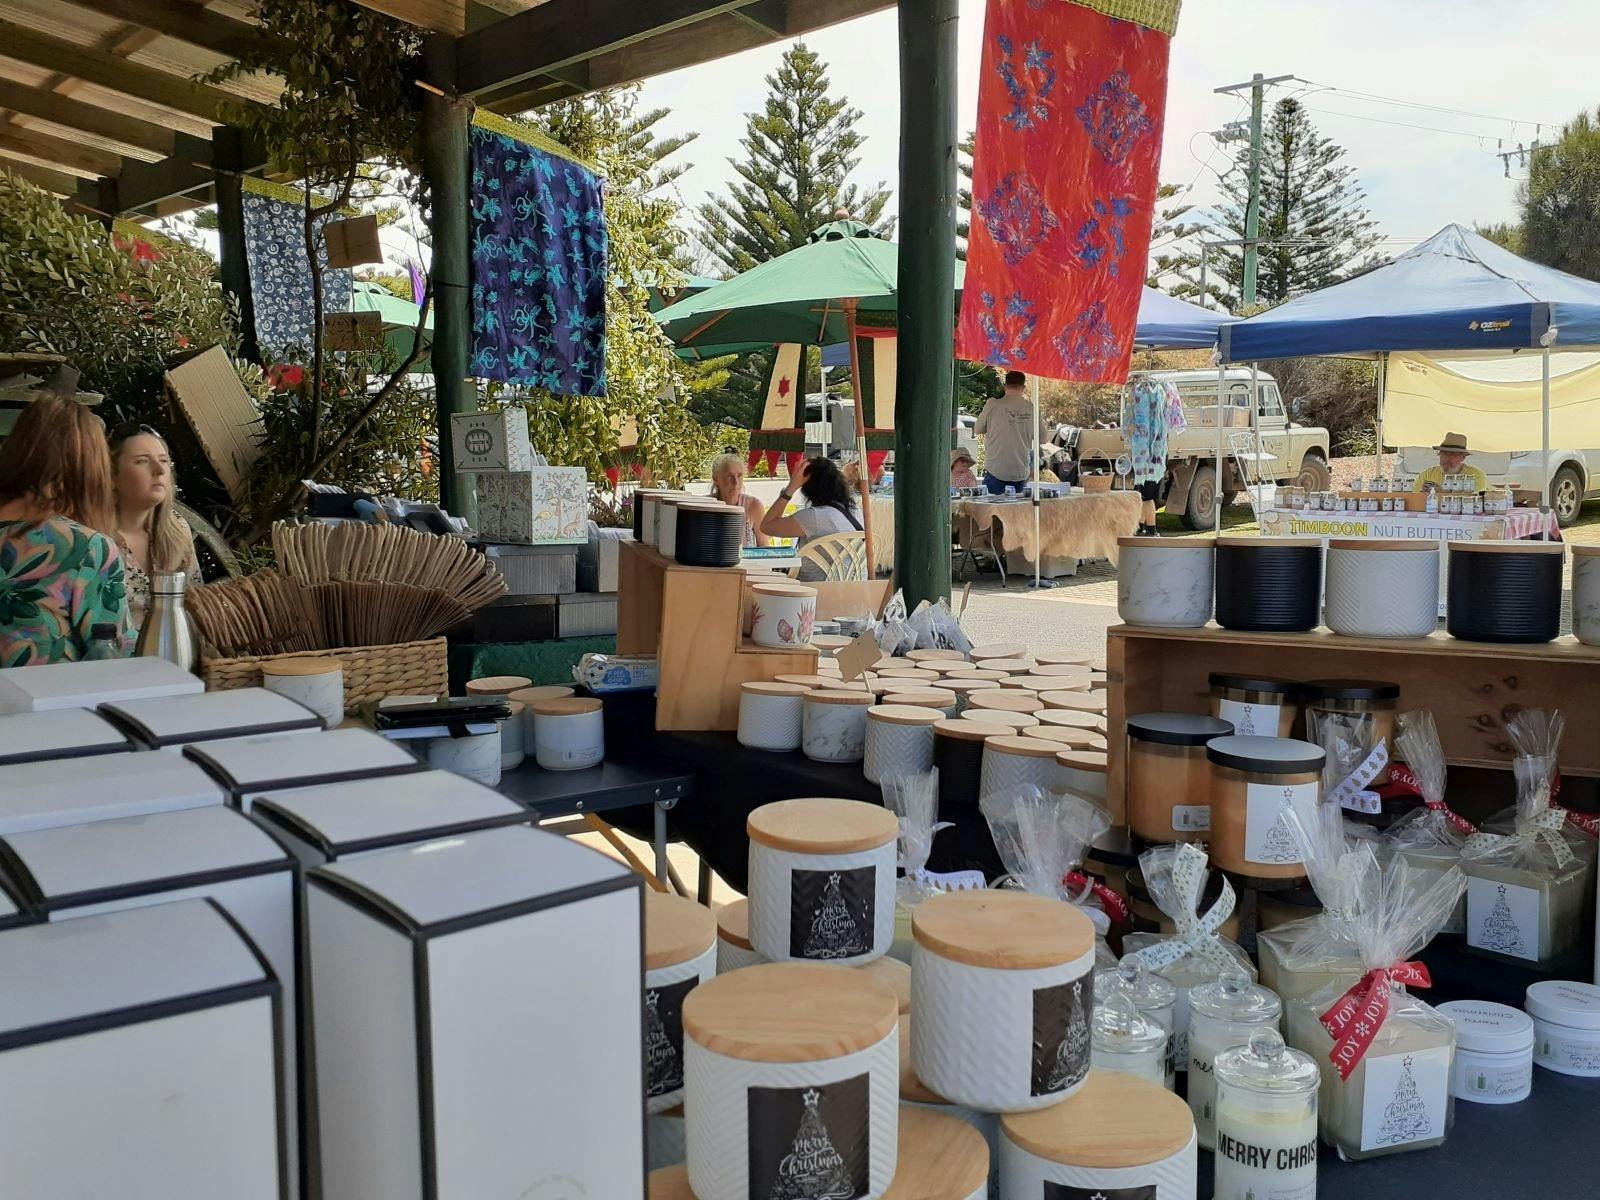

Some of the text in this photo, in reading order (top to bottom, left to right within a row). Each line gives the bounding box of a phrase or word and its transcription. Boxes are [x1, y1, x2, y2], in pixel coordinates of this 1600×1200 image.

[1289, 519, 1473, 541] TIMBOON NUT BUTTERS
[1334, 1001, 1357, 1029] JOY
[1364, 996, 1385, 1025] JOY
[1337, 1035, 1361, 1066] JOY
[1384, 1100, 1425, 1120] Christmas
[1217, 1129, 1317, 1170] MERRY CHRIS
[779, 1151, 843, 1177] Christmas
